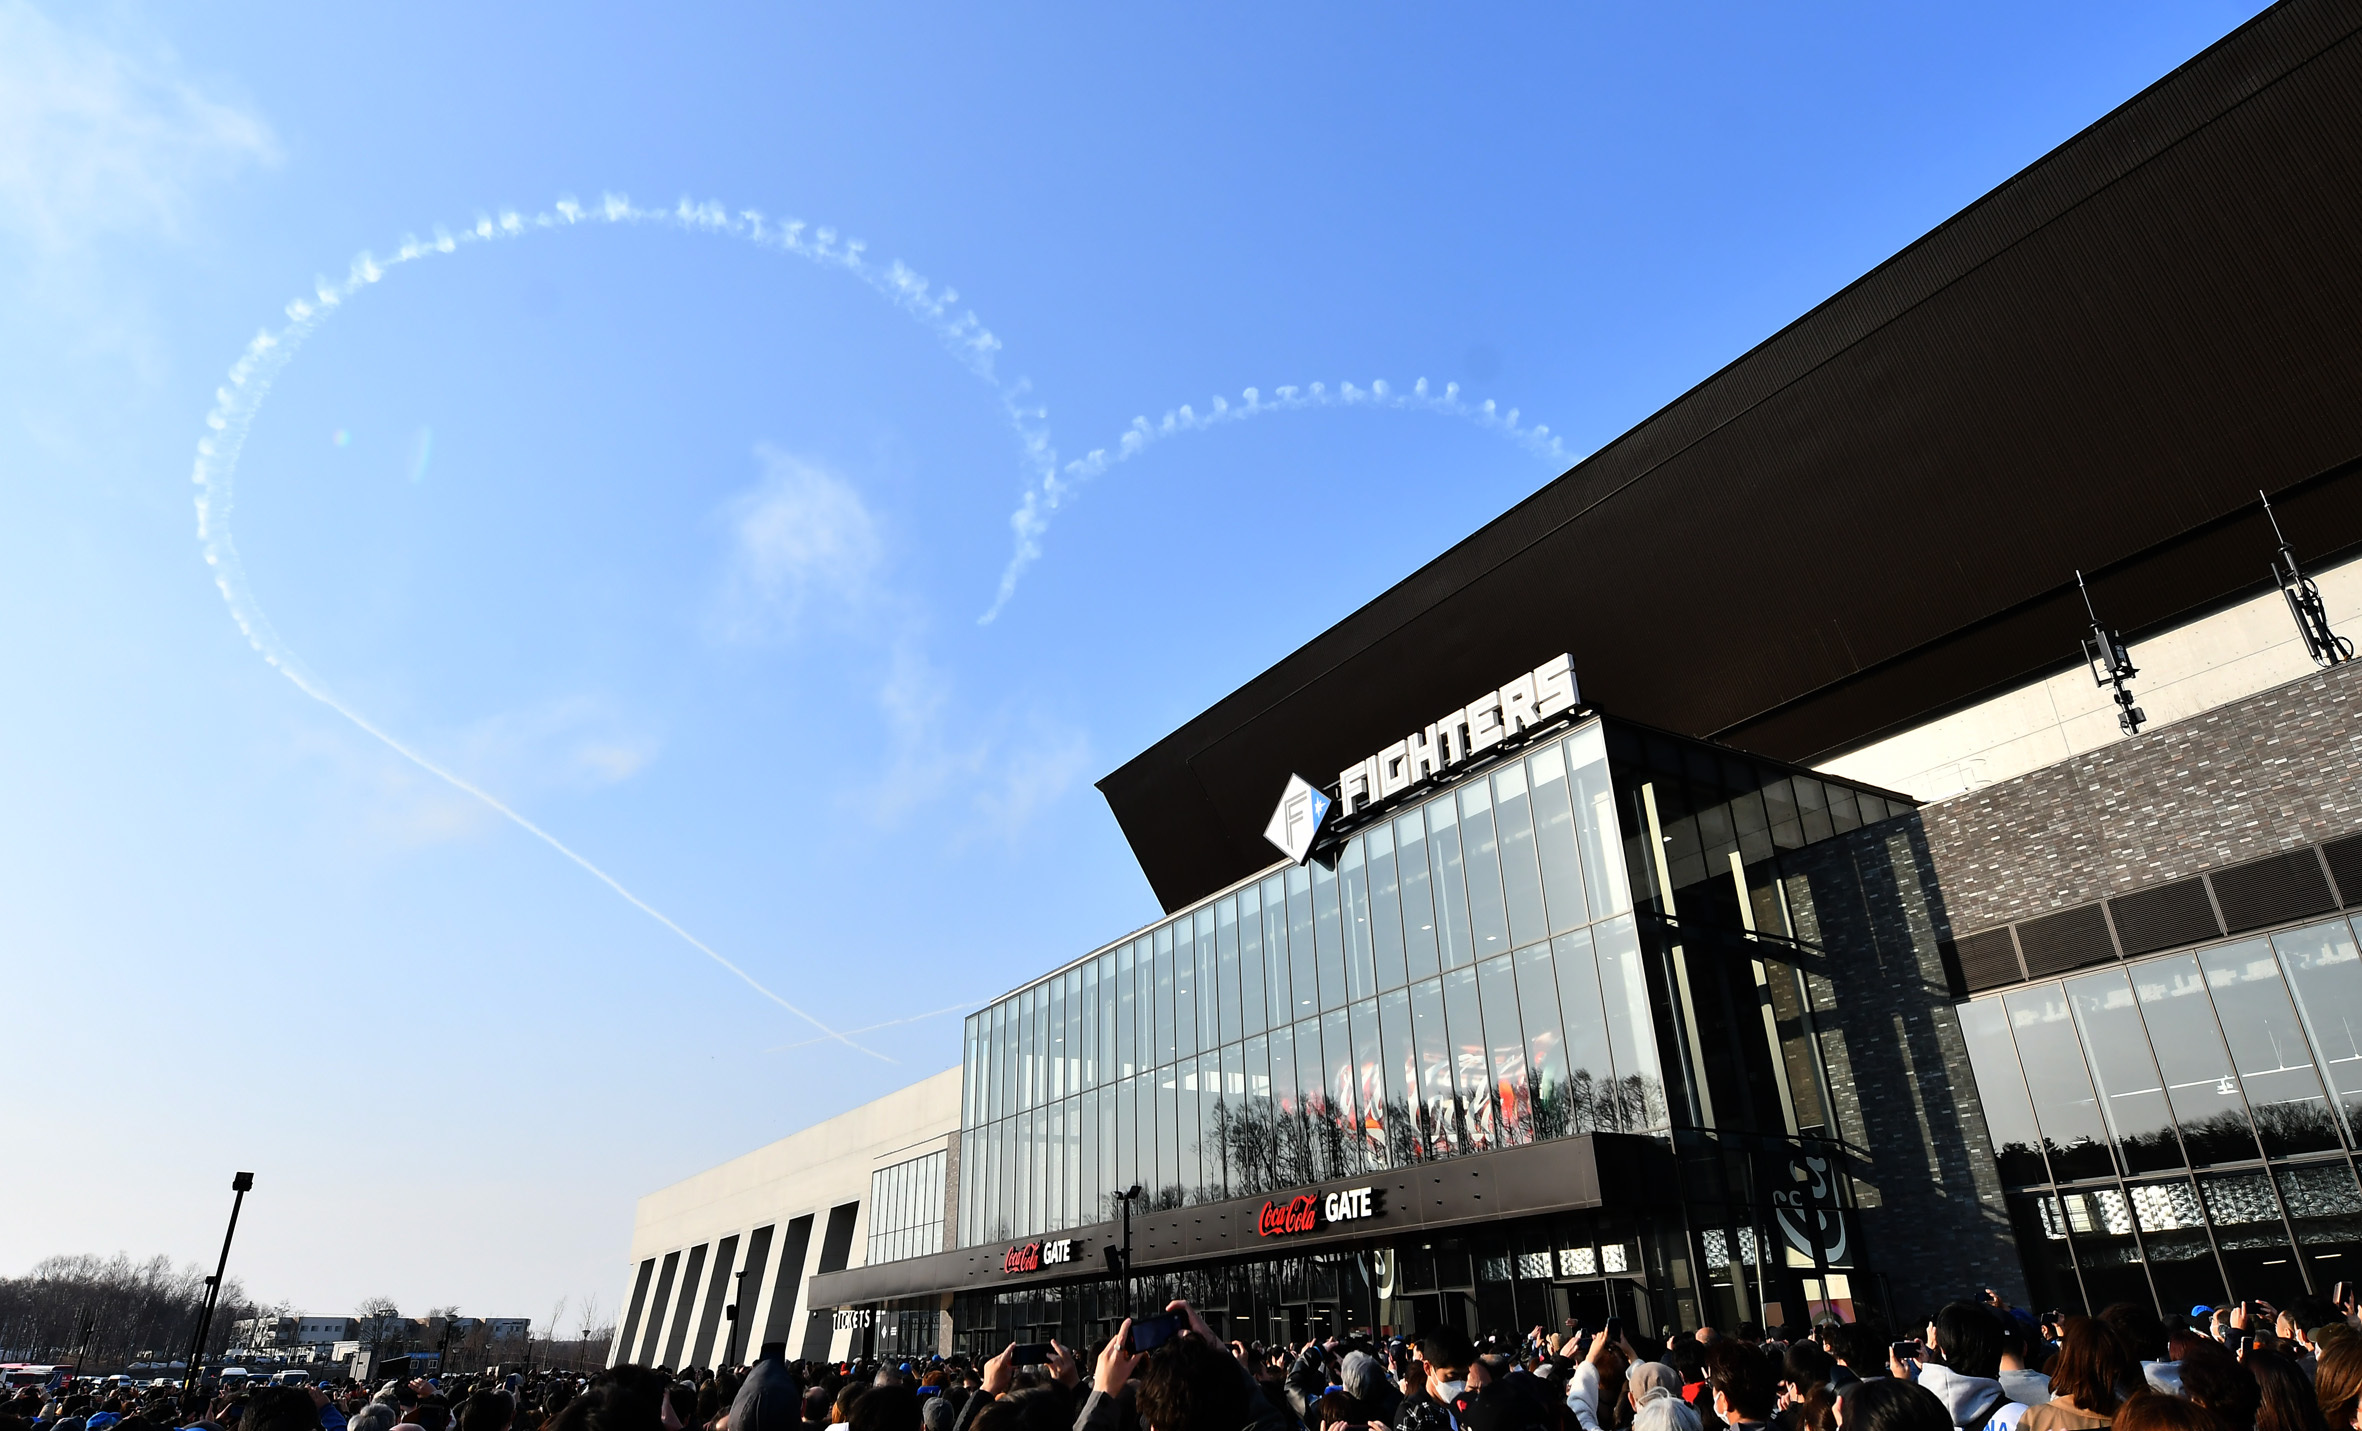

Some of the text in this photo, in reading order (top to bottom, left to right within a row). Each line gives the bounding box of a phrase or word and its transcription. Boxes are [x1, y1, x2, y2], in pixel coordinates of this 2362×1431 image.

[1339, 652, 1581, 818] FIGHTERS
[1258, 1186, 1372, 1237] Coca-Cola GATE
[1004, 1238, 1071, 1274] Coca-Cola GATE
[832, 1309, 871, 1331] TICKETS
